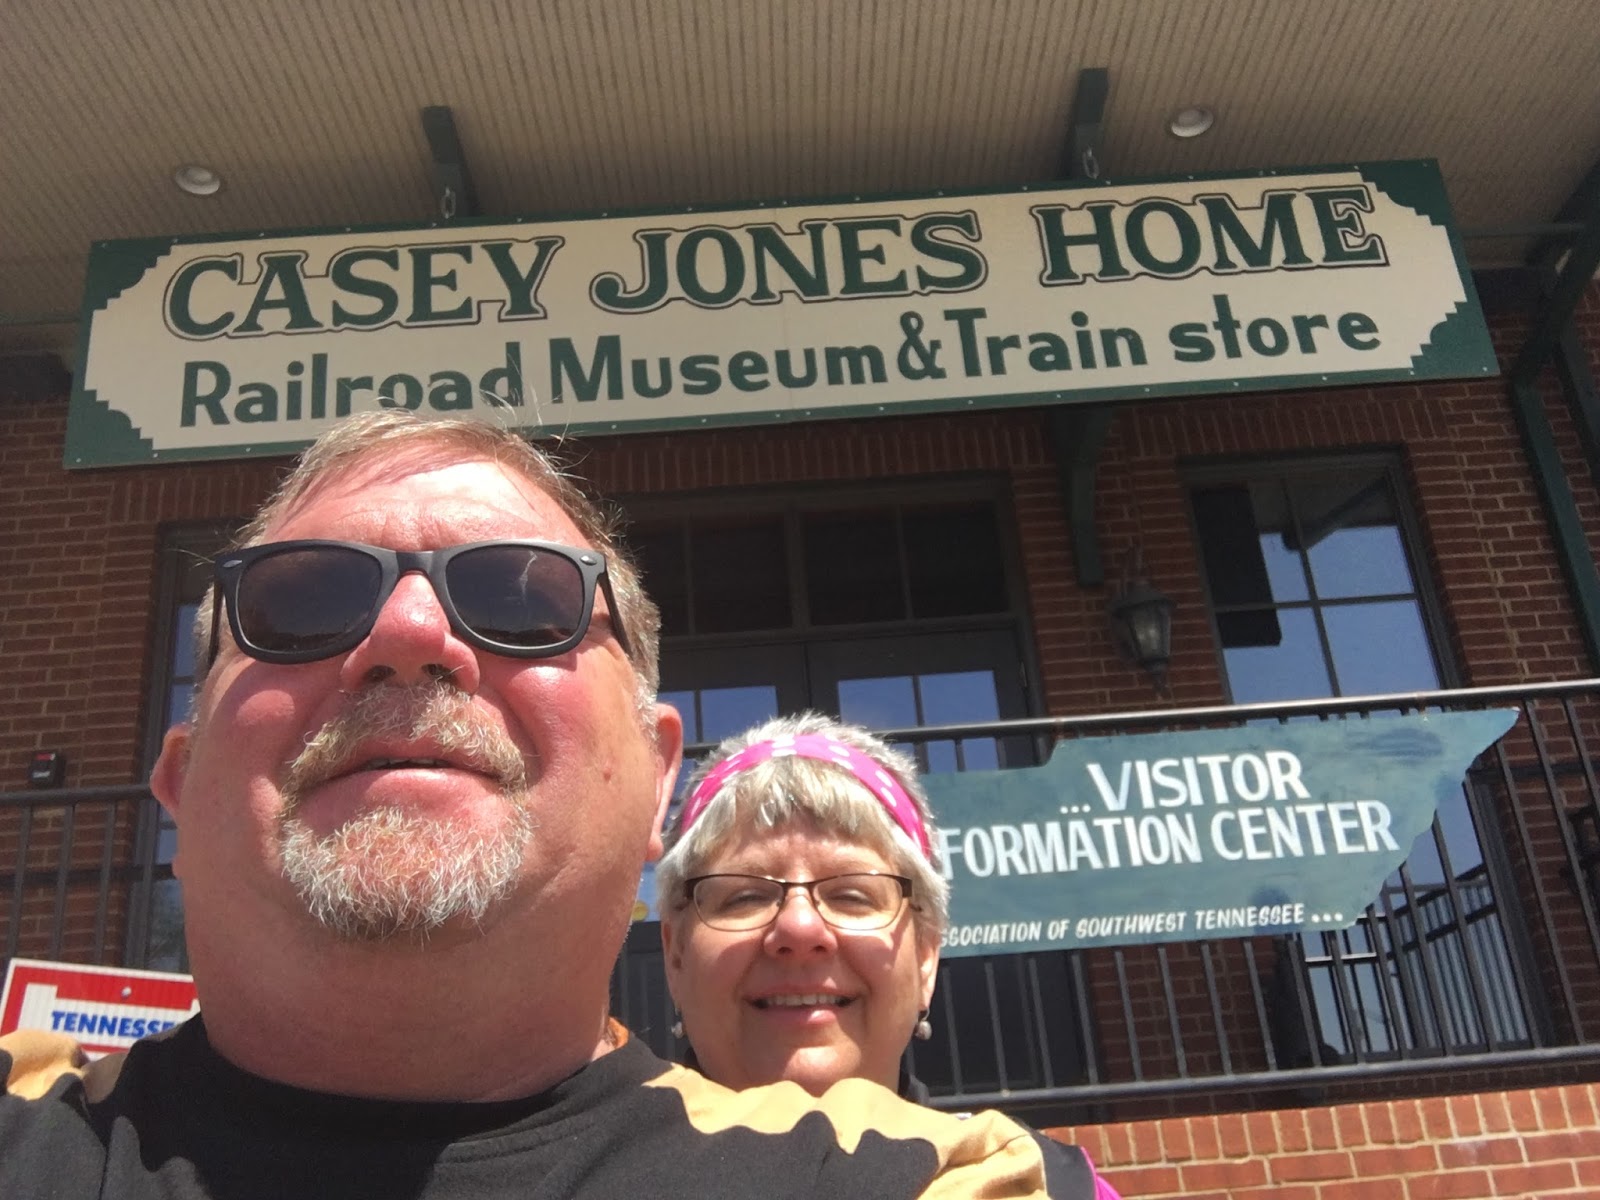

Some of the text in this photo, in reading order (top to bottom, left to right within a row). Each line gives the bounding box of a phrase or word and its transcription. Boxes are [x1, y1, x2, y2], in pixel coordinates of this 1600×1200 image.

[162, 184, 1390, 340] CASEY JONES HOME
[180, 341, 525, 427] Railroad
[549, 335, 888, 405] Museum
[1169, 294, 1381, 363] store
[1210, 800, 1400, 861] CENTER
[1047, 919, 1070, 941] OF
[1075, 911, 1187, 940] SOUTHWEST
